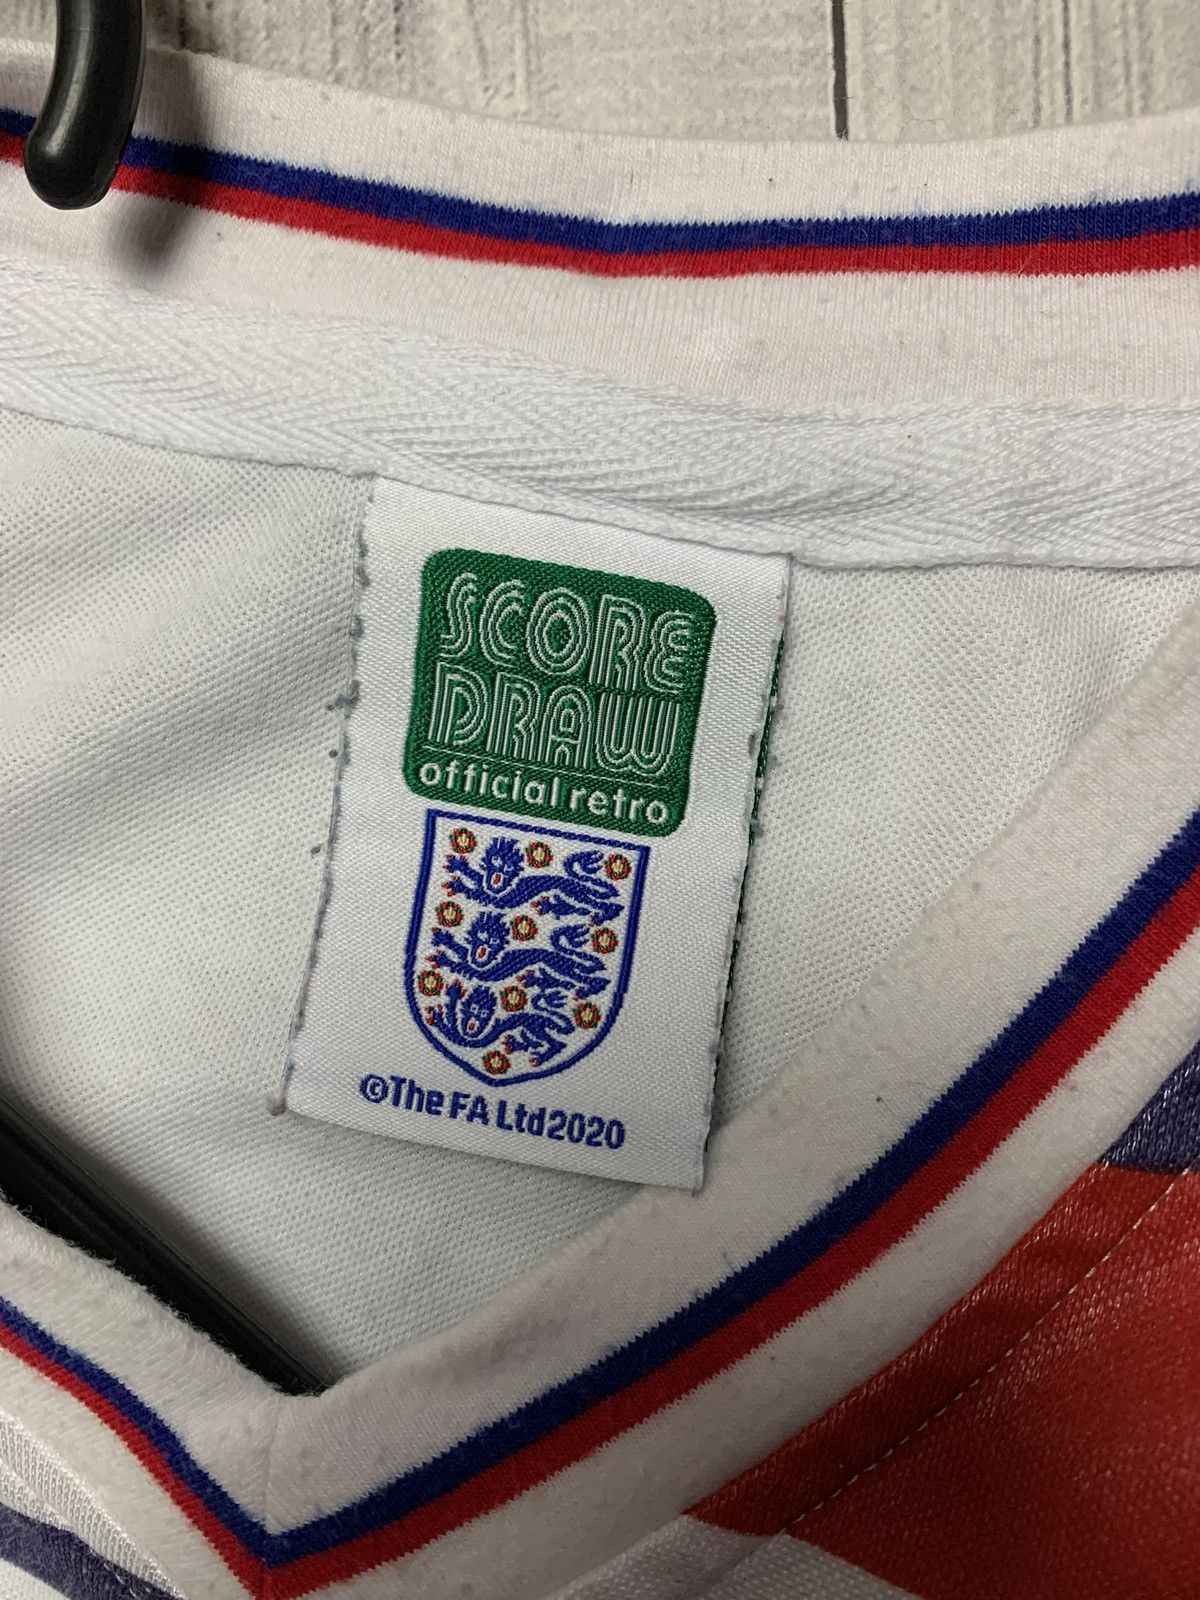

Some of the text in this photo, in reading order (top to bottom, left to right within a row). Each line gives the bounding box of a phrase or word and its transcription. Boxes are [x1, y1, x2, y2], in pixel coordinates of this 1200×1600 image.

[439, 571, 697, 694] SCORE
[427, 661, 681, 777] DRAW
[418, 760, 670, 825] official retro
[449, 1091, 490, 1126] FA
